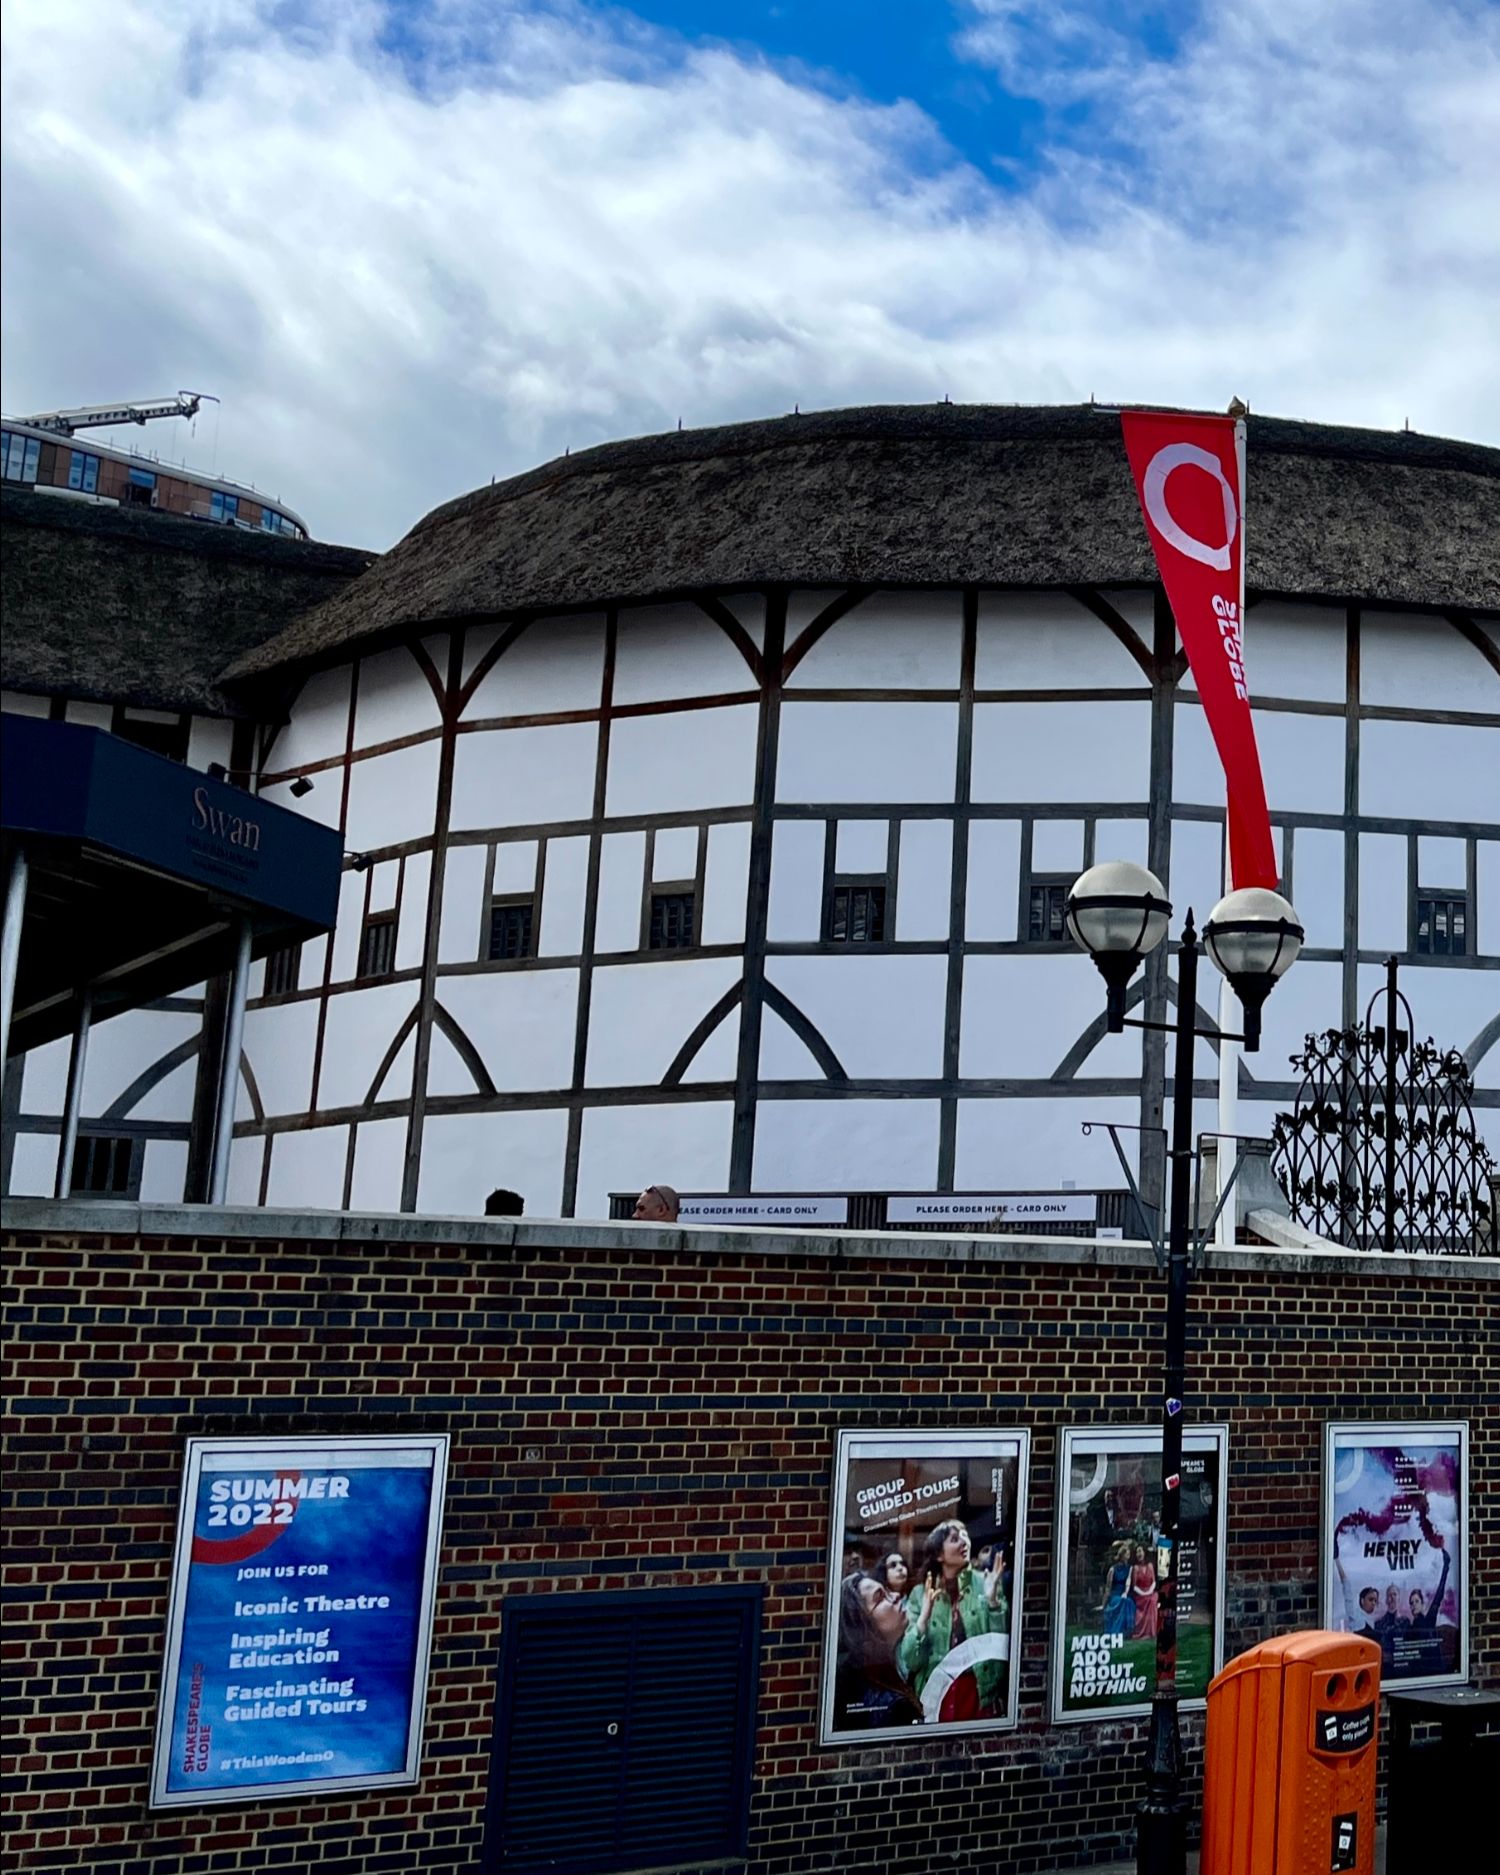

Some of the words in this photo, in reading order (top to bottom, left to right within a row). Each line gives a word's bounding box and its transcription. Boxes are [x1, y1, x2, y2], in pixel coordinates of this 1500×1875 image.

[192, 787, 260, 851] Swan
[679, 1206, 702, 1214] EASE
[703, 1206, 734, 1214] ORDER
[736, 1206, 759, 1214] HERE
[767, 1206, 792, 1214] CARD
[794, 1206, 818, 1214] ONLY
[916, 1206, 950, 1214] PLEASE
[952, 1206, 982, 1214] ORDER
[985, 1205, 1008, 1213] HERE
[1016, 1204, 1041, 1212] CARD
[1044, 1204, 1067, 1212] ONLY
[210, 1476, 350, 1502] SUMMER
[856, 1478, 905, 1504] GROUP
[860, 1491, 913, 1518] GUIDED
[913, 1476, 960, 1501] TOURS
[208, 1502, 294, 1526] 2022
[1364, 1540, 1422, 1558] HENRY
[237, 1566, 271, 1582] JOIN
[274, 1565, 294, 1578] US
[298, 1564, 329, 1578] FOR
[1388, 1555, 1414, 1571] VIII
[234, 1597, 300, 1617] Iconic
[304, 1594, 390, 1613] Theatre
[231, 1628, 330, 1651] Inspiring
[1071, 1633, 1124, 1652] MUCH
[229, 1647, 340, 1669] Education
[1072, 1650, 1110, 1668] ADO
[1072, 1662, 1134, 1683] ABOUT
[226, 1677, 354, 1702] Fascinating
[1070, 1676, 1147, 1698] NOTHING
[224, 1700, 301, 1722] Guided
[307, 1697, 368, 1716] Tours
[1342, 1732, 1354, 1742] only
[197, 1725, 211, 1772] GLOBE
[220, 1750, 334, 1771] #ThisWoodenO
